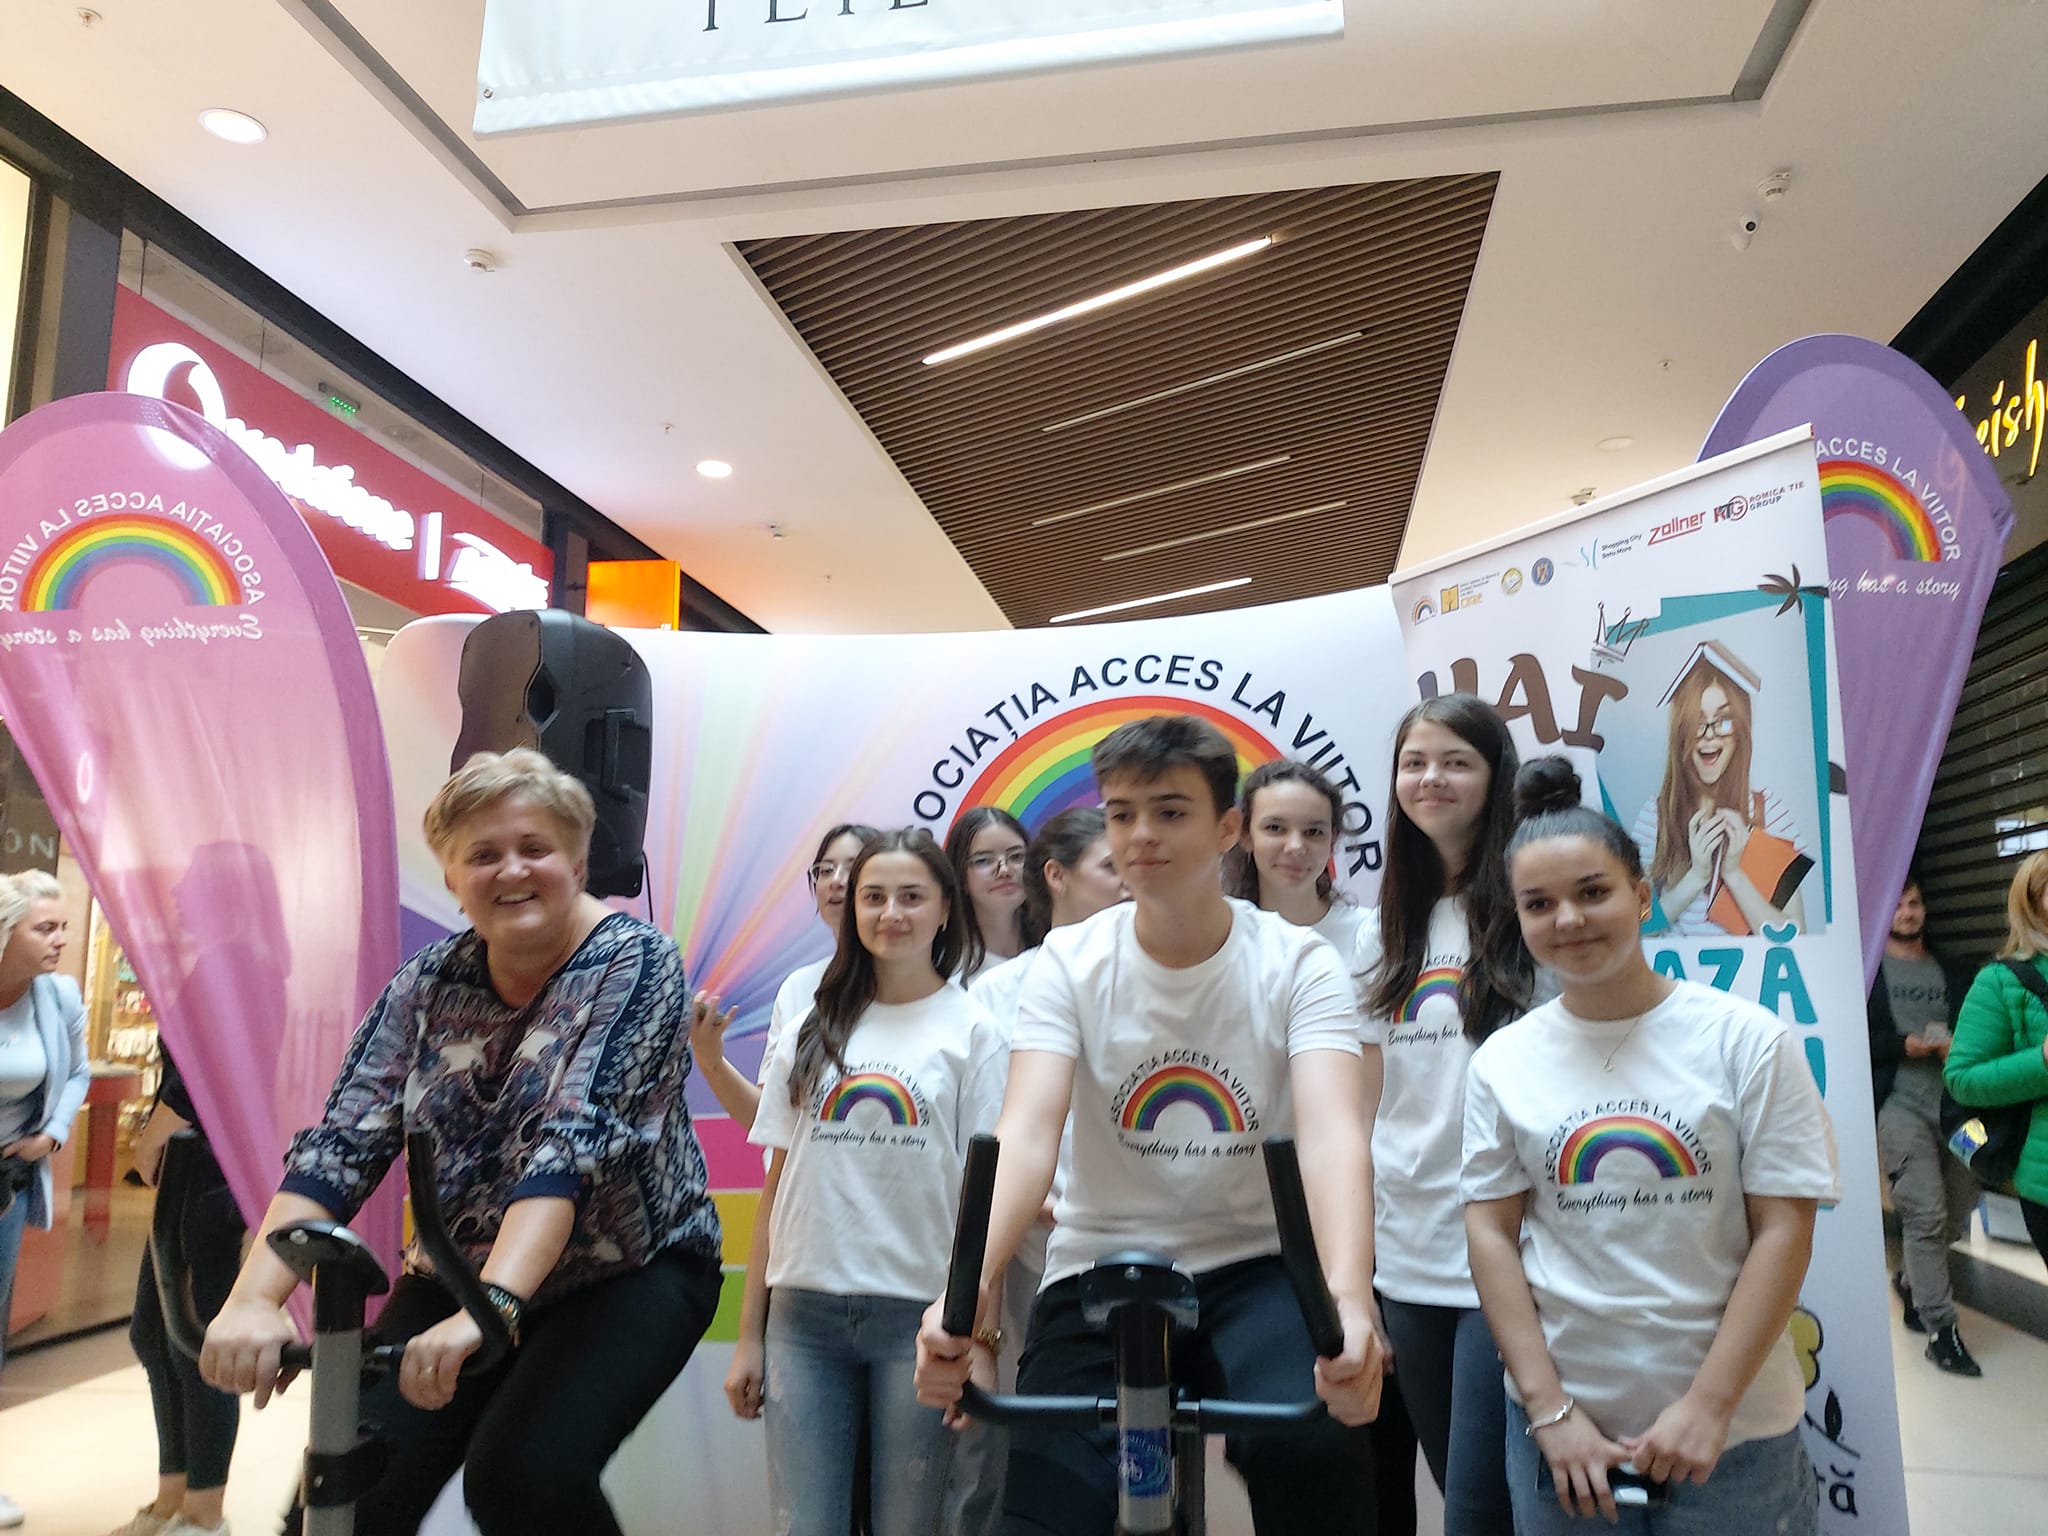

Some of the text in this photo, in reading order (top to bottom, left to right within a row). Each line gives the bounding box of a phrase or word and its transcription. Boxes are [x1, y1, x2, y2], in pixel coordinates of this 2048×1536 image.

[1788, 481, 1805, 492] TIE
[1815, 437, 1961, 562] ACCES LA VIITOR
[1750, 495, 1782, 511] GROUP
[1856, 568, 1890, 593] has
[1895, 581, 1909, 594] a
[1916, 576, 1961, 602] story
[906, 654, 1383, 878] OCIAȚIA ACCES LA VIITOR
[1387, 1024, 1458, 1047] Everything has
[1163, 1049, 1210, 1067] ACCES
[1212, 1059, 1230, 1082] LA
[1230, 1076, 1260, 1133] VIITOR
[810, 1125, 928, 1151] Everything has a story
[1184, 1138, 1207, 1158] has
[1211, 1146, 1222, 1157] a
[1226, 1143, 1257, 1159] story
[1595, 1099, 1650, 1116] ACCES
[1652, 1103, 1672, 1124] LA
[1675, 1117, 1712, 1176] VIITOR
[1557, 1187, 1713, 1215] Everything has a story
